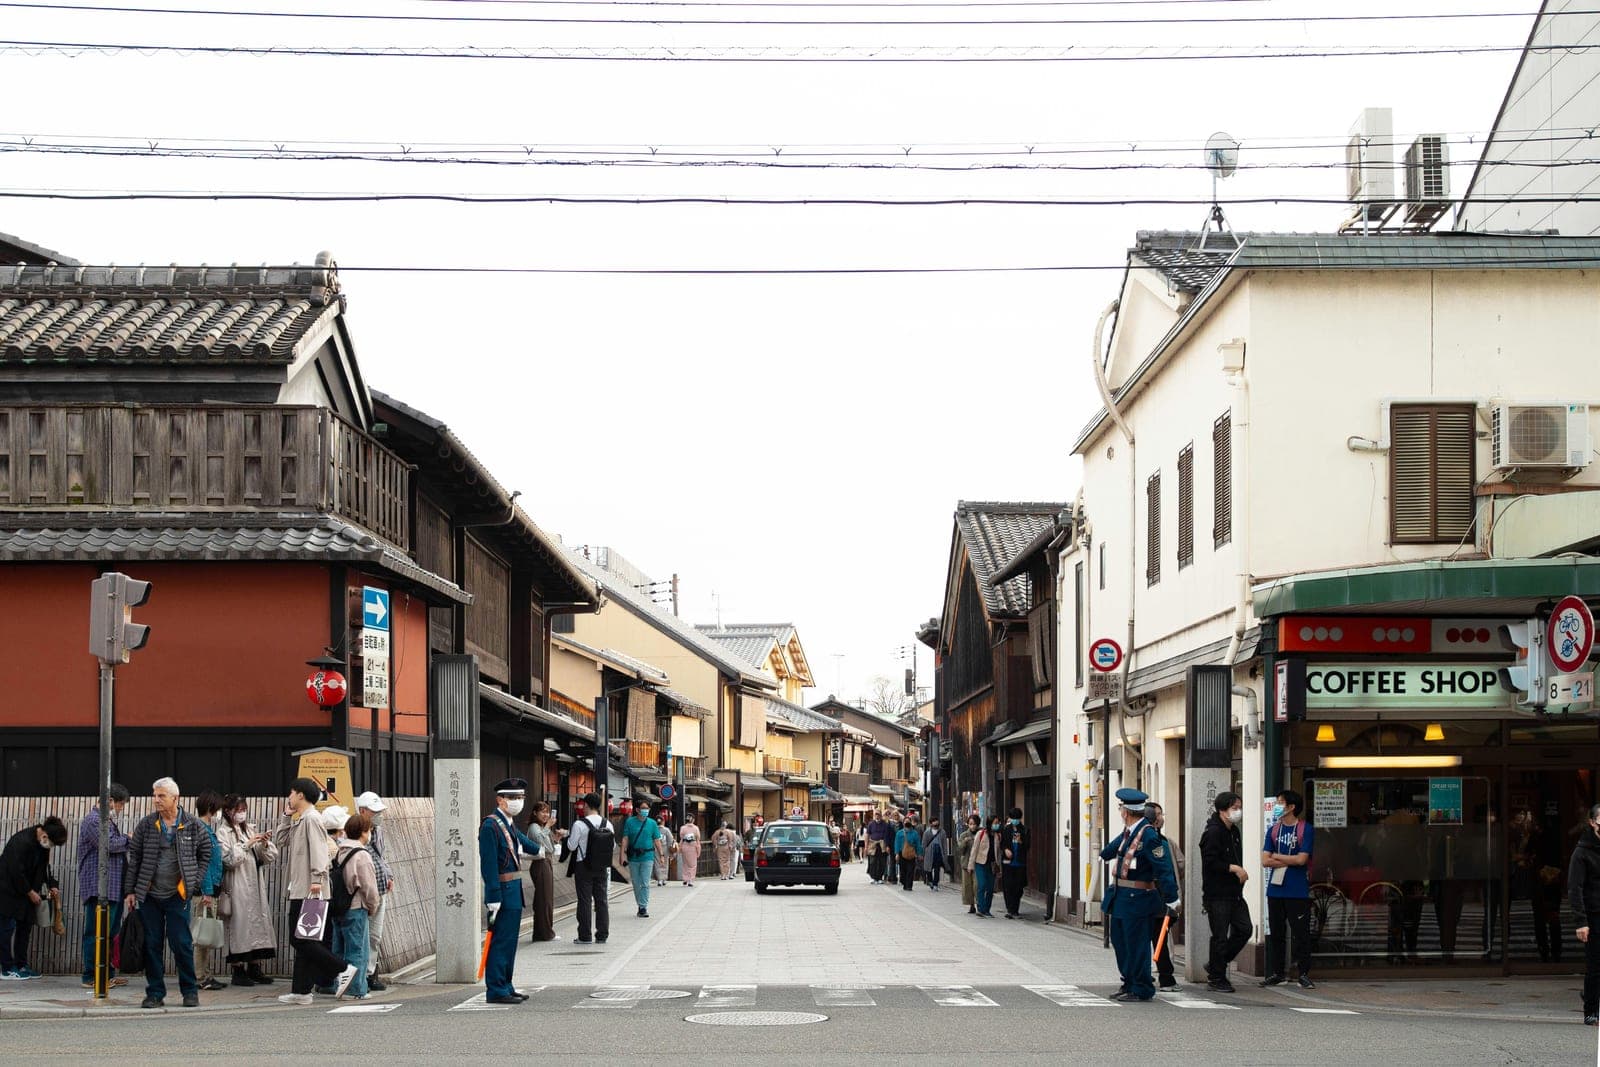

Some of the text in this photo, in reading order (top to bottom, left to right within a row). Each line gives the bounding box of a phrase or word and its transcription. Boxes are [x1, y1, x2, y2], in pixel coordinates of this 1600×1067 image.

[1306, 670, 1407, 694] COFFEE
[1420, 670, 1498, 694] SHOP
[444, 828, 465, 908] 花見小路
